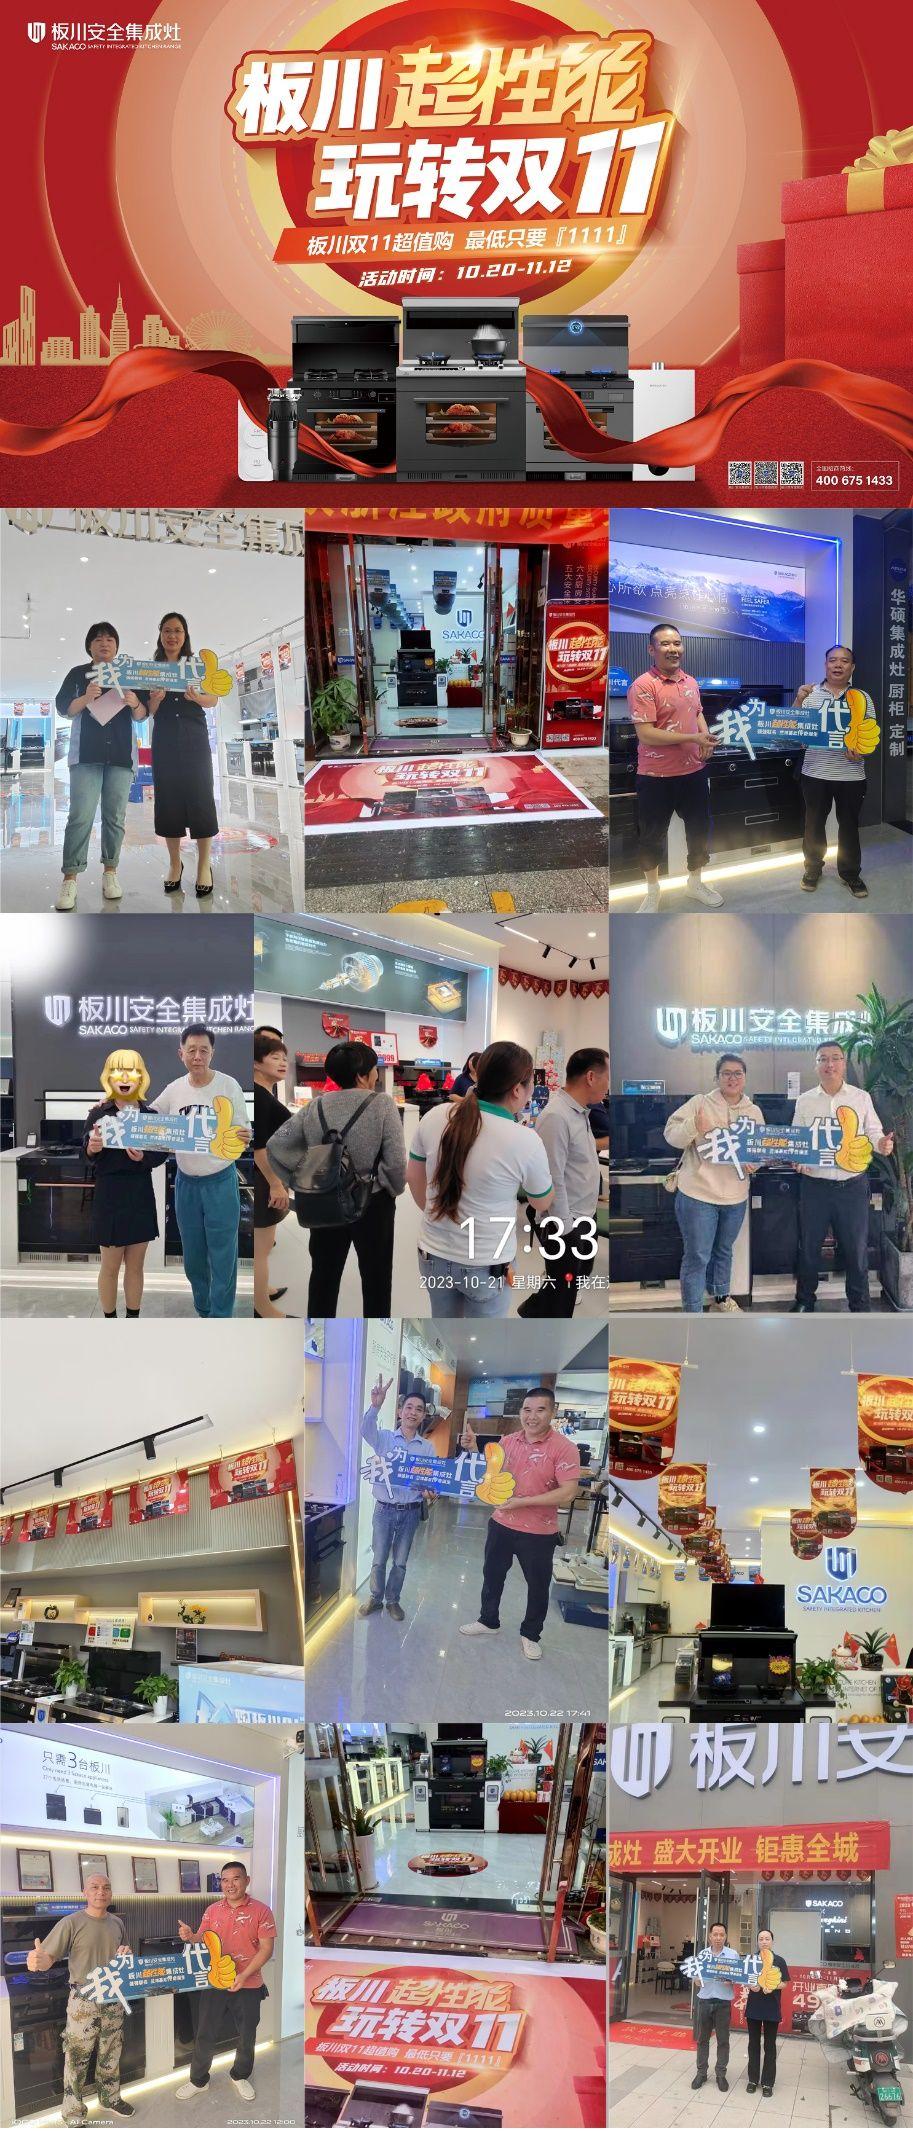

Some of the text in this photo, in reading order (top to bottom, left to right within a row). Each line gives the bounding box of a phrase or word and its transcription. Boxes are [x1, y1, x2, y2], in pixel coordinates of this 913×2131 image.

[51, 22, 181, 41] 板川安全集成灶
[314, 122, 669, 220] 玩转双11
[307, 229, 453, 256] 板川双11超值购
[816, 476, 893, 486] 400 675 1433
[888, 588, 906, 757] 华硕集成灶 厨柜 定制
[78, 995, 254, 1022] 板川安全集成灶
[79, 1025, 128, 1035] SAKACO
[692, 1034, 743, 1044] SAKACO
[613, 1392, 674, 1411] 玩转双11
[797, 1586, 888, 1604] SAKACO
[42, 1751, 110, 1774] 只需3台板川
[653, 1837, 742, 1866] 盛大开业
[755, 1832, 860, 1864] 钜惠全城
[812, 1900, 844, 1908] SAKACO
[330, 2006, 522, 2052] 玩转双11
[315, 2042, 400, 2058] 板川双11超值购
